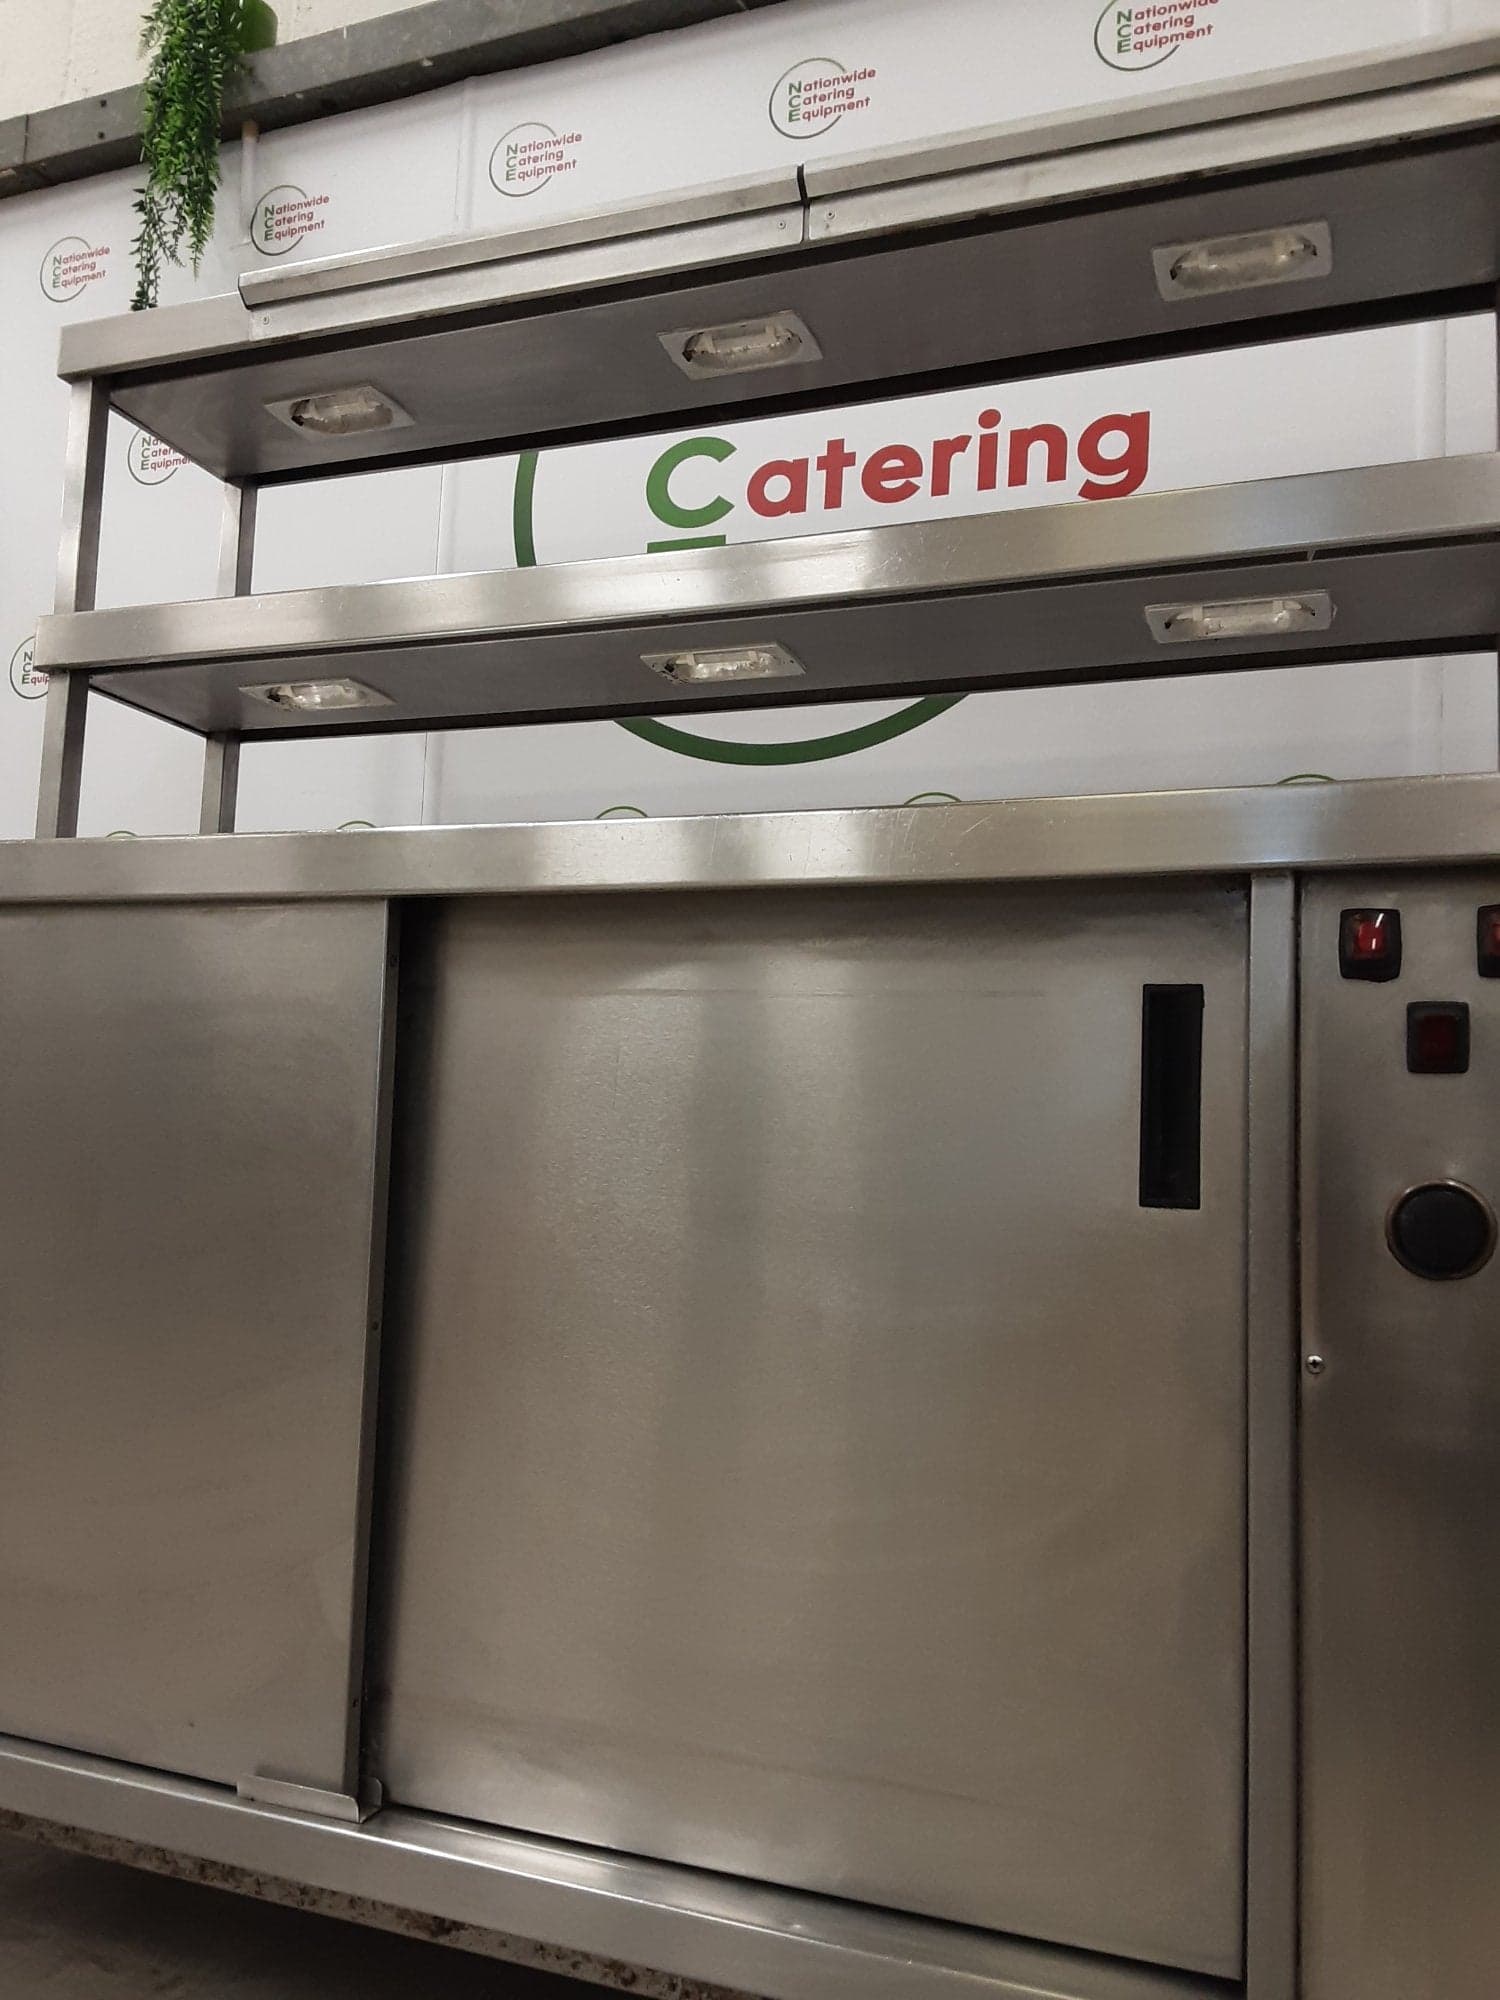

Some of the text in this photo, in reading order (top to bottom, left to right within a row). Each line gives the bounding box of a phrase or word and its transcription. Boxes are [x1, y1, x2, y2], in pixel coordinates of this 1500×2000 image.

[1117, 15, 1194, 38] Catering
[1117, 24, 1213, 53] Equipment
[788, 68, 876, 95] Nationwide
[788, 88, 854, 108] Catering
[788, 97, 870, 122] Equipment
[506, 133, 582, 156] Nationwide
[506, 150, 564, 168] Catering
[505, 159, 577, 182] Equipment
[264, 195, 330, 217] Nationwide
[264, 211, 314, 229] Catering
[264, 220, 325, 241] Equipment
[53, 246, 110, 265] Nationwide
[52, 261, 96, 277] Catering
[52, 270, 106, 288] Equipment
[646, 408, 1151, 529] Catering
